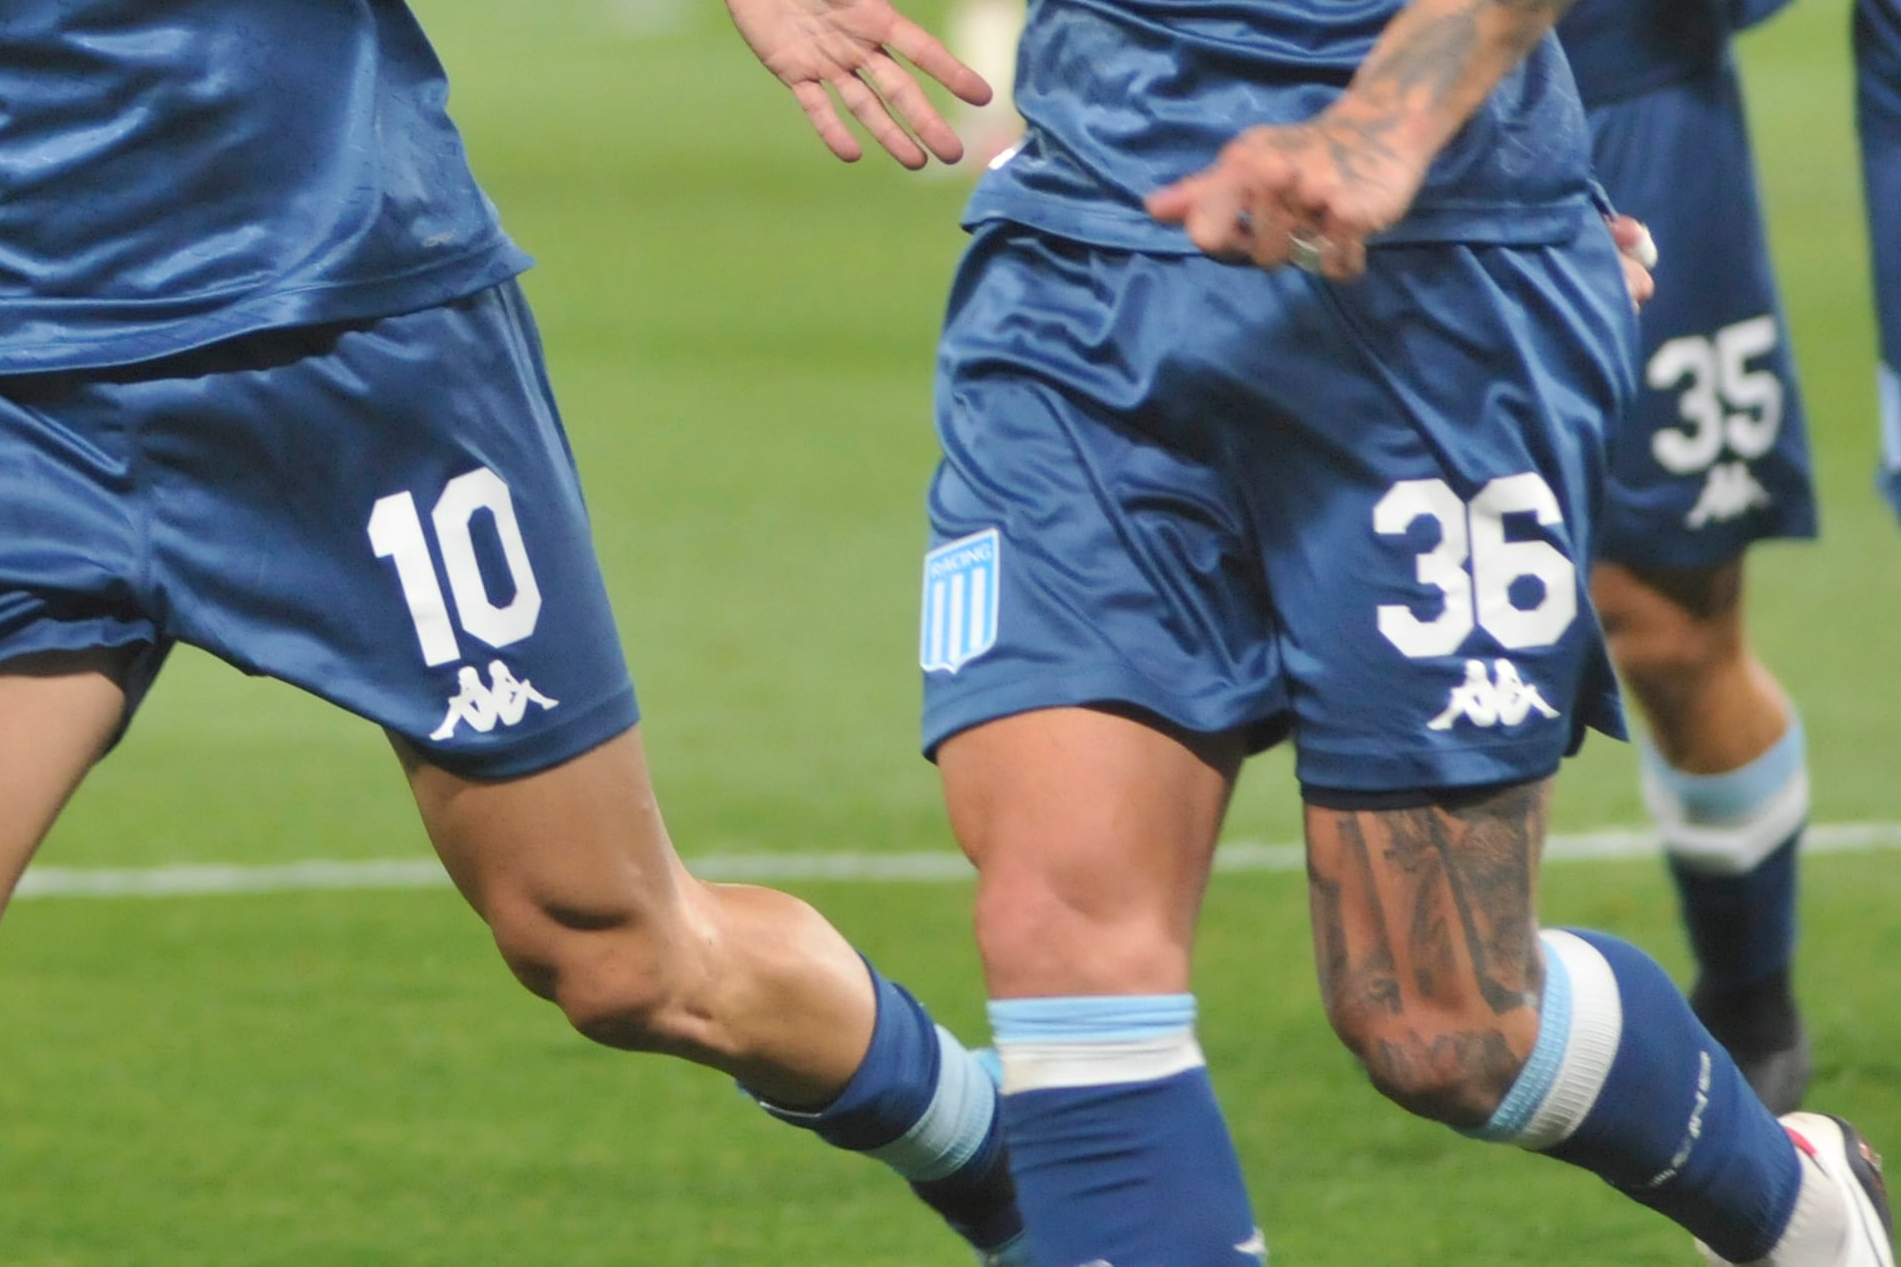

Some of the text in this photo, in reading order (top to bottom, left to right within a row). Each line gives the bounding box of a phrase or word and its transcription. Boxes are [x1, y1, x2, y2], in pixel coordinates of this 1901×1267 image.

[1648, 316, 1782, 475] 35
[367, 466, 543, 669] 10
[1372, 472, 1577, 658] 36
